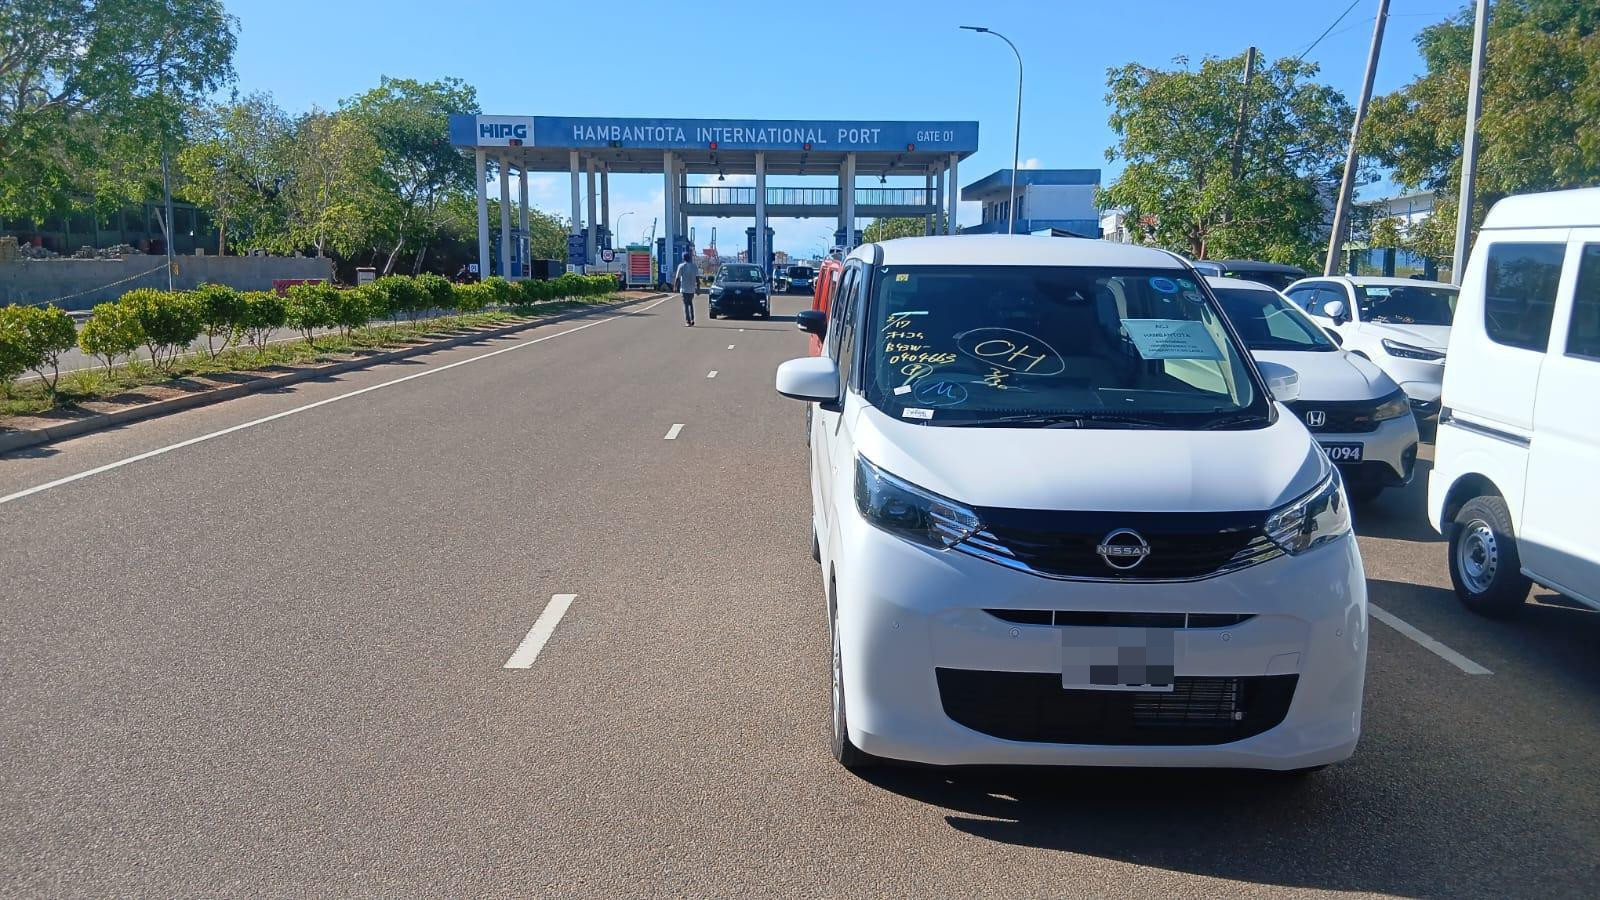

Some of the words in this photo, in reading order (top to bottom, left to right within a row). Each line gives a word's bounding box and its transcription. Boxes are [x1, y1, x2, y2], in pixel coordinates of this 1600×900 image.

[573, 125, 686, 142] HAMBANTOTA
[697, 127, 827, 144] INTERNATIONAL
[838, 129, 881, 143] PORT
[916, 131, 940, 142] GATE
[943, 131, 954, 142] 01
[1097, 545, 1150, 555] NISSAN
